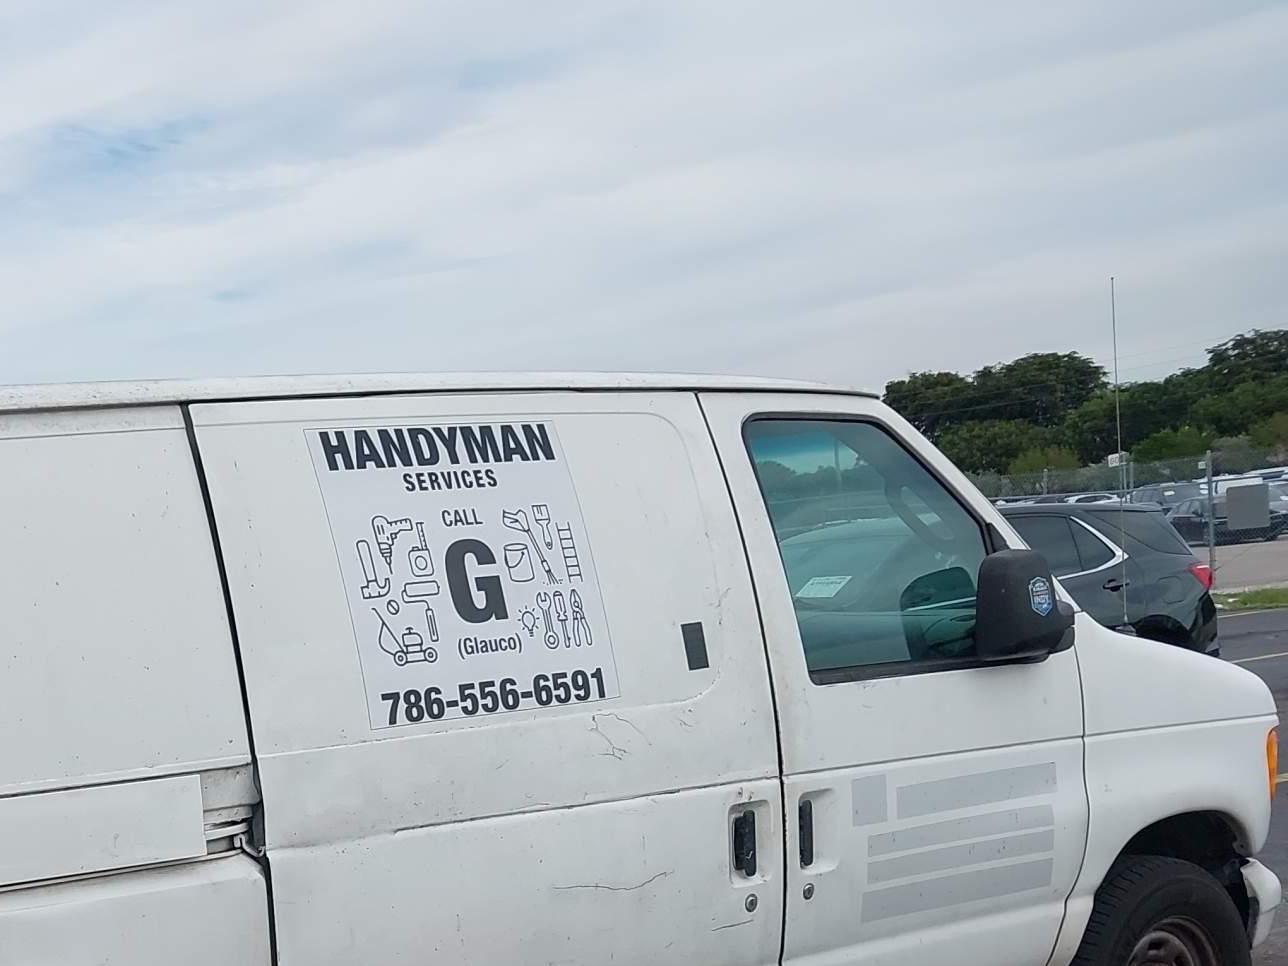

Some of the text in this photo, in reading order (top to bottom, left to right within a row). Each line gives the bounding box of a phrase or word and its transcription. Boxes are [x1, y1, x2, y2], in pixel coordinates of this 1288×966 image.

[319, 423, 556, 472] HANDYMAN
[402, 469, 498, 492] SERVICES
[441, 508, 483, 527] CALL
[444, 538, 510, 624] G
[457, 632, 523, 660] (Glauco)
[380, 667, 606, 726] 786-556-6591
